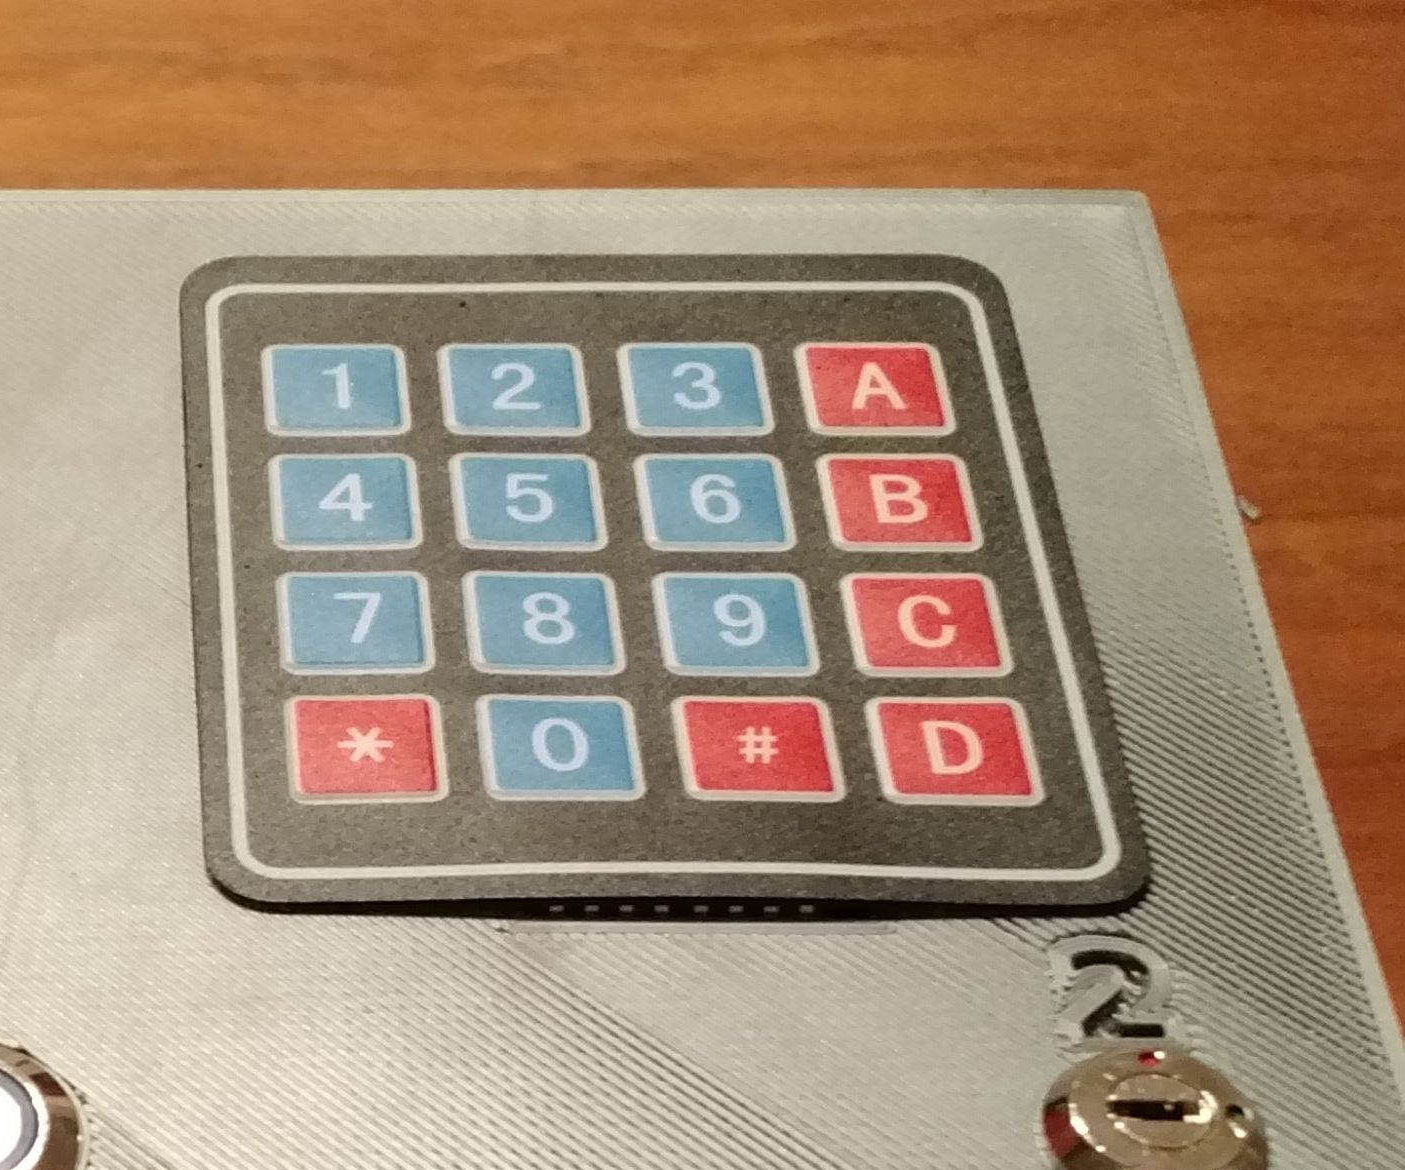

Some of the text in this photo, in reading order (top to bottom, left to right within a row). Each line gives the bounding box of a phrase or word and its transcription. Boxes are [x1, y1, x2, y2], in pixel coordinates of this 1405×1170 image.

[322, 361, 907, 411] 1 2 3 A
[318, 473, 928, 524] 4 5 6 B
[333, 591, 956, 649] 7 8 9 C
[531, 717, 589, 772] 0
[736, 726, 779, 764] #
[920, 719, 984, 775] D
[1071, 949, 1165, 1038] 2
